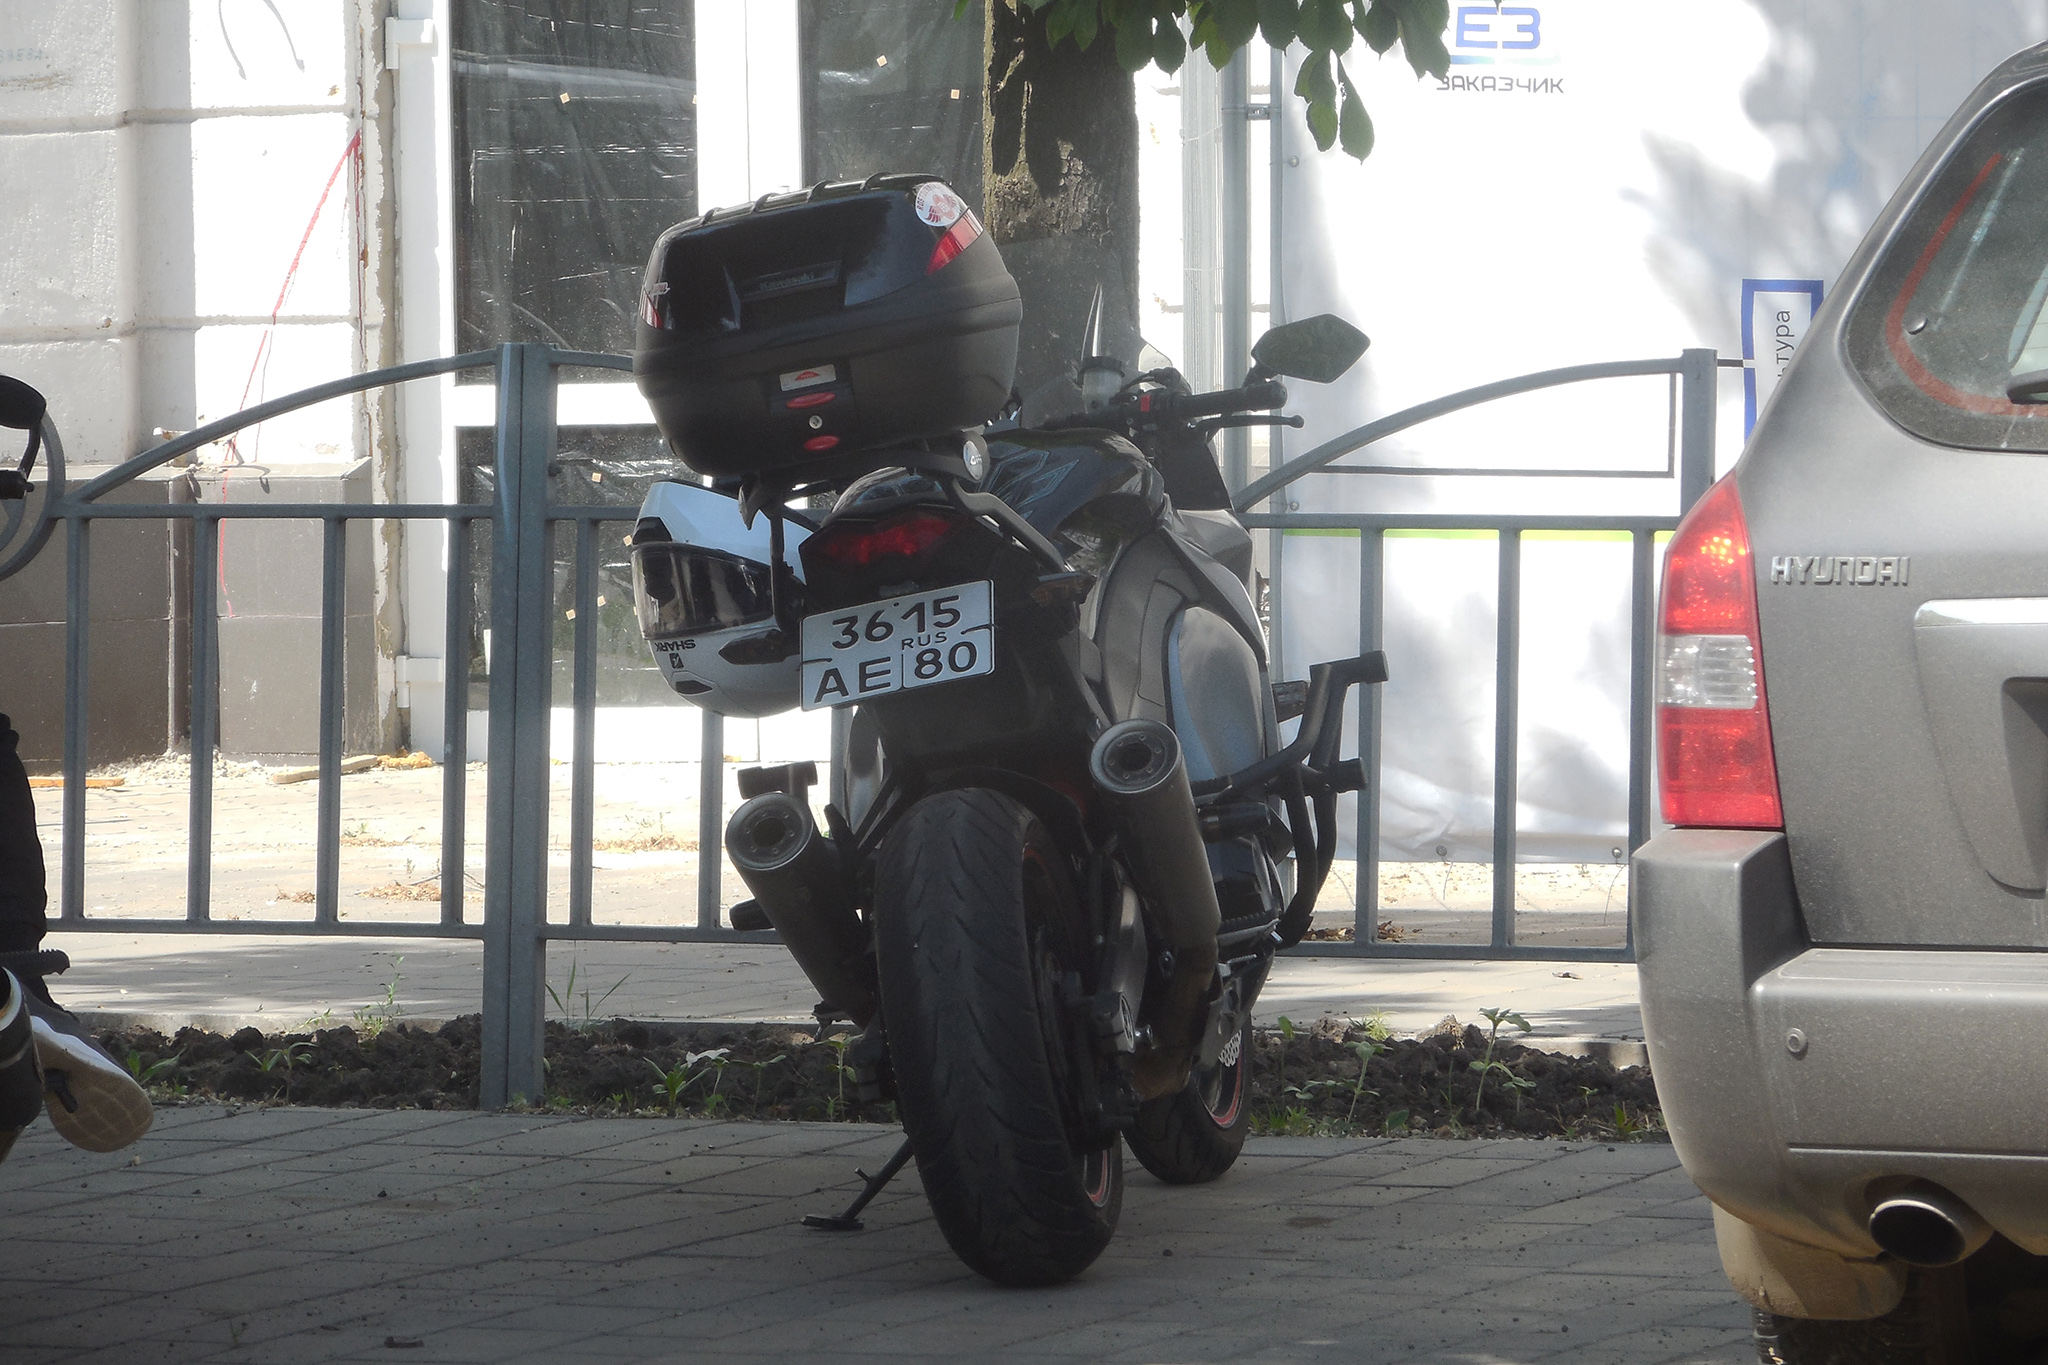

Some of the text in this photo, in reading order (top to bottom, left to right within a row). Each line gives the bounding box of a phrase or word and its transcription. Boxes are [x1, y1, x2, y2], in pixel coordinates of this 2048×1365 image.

[1436, 75, 1565, 94] ЗАКАЗЧИК
[1775, 310, 1795, 378] тура
[1770, 556, 1911, 586] HYUNDAI
[832, 595, 961, 650] 3615
[654, 639, 697, 652] SHARK
[901, 631, 948, 651] RUS
[914, 641, 978, 680] 80
